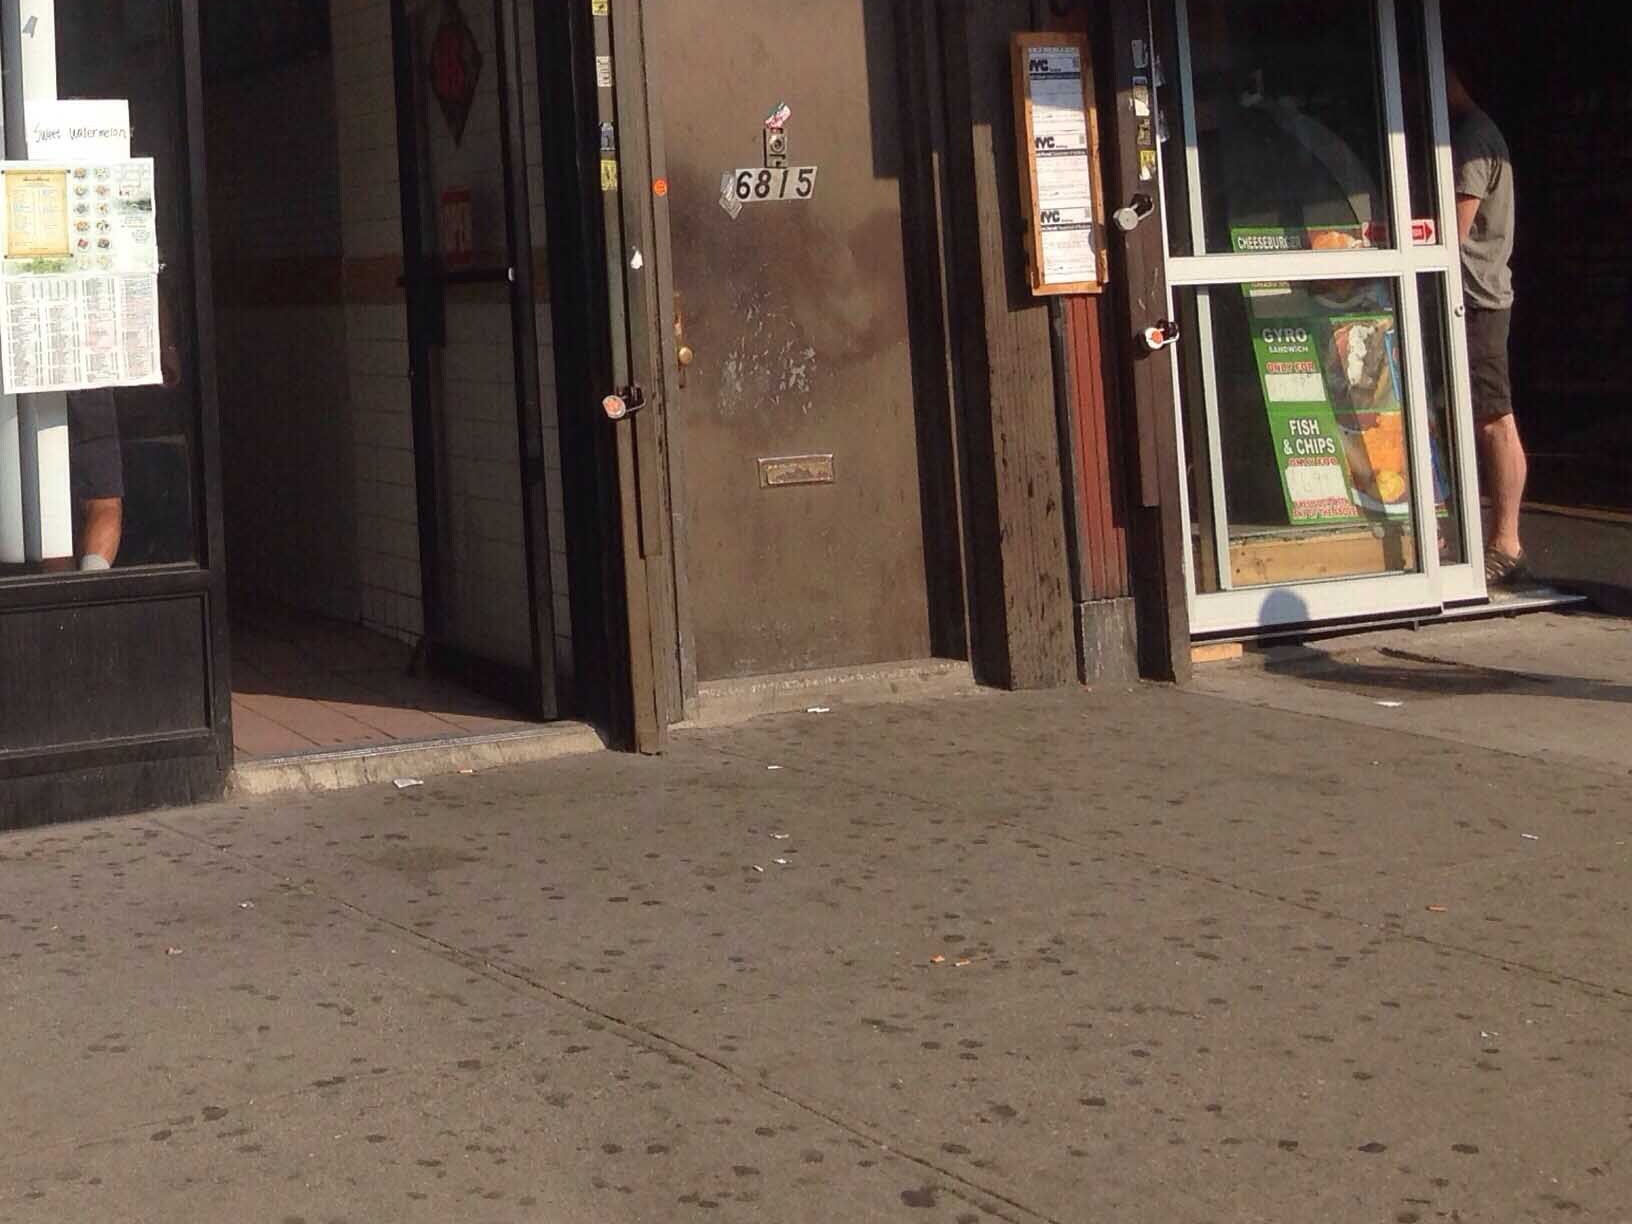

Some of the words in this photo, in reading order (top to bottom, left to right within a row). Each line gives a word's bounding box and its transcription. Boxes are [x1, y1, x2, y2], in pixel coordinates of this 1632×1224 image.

[735, 168, 814, 200] 6815
[1262, 327, 1308, 344] GYRO
[1289, 419, 1320, 436] FISH
[1283, 438, 1294, 455] &
[1295, 437, 1336, 455] CHIPS
